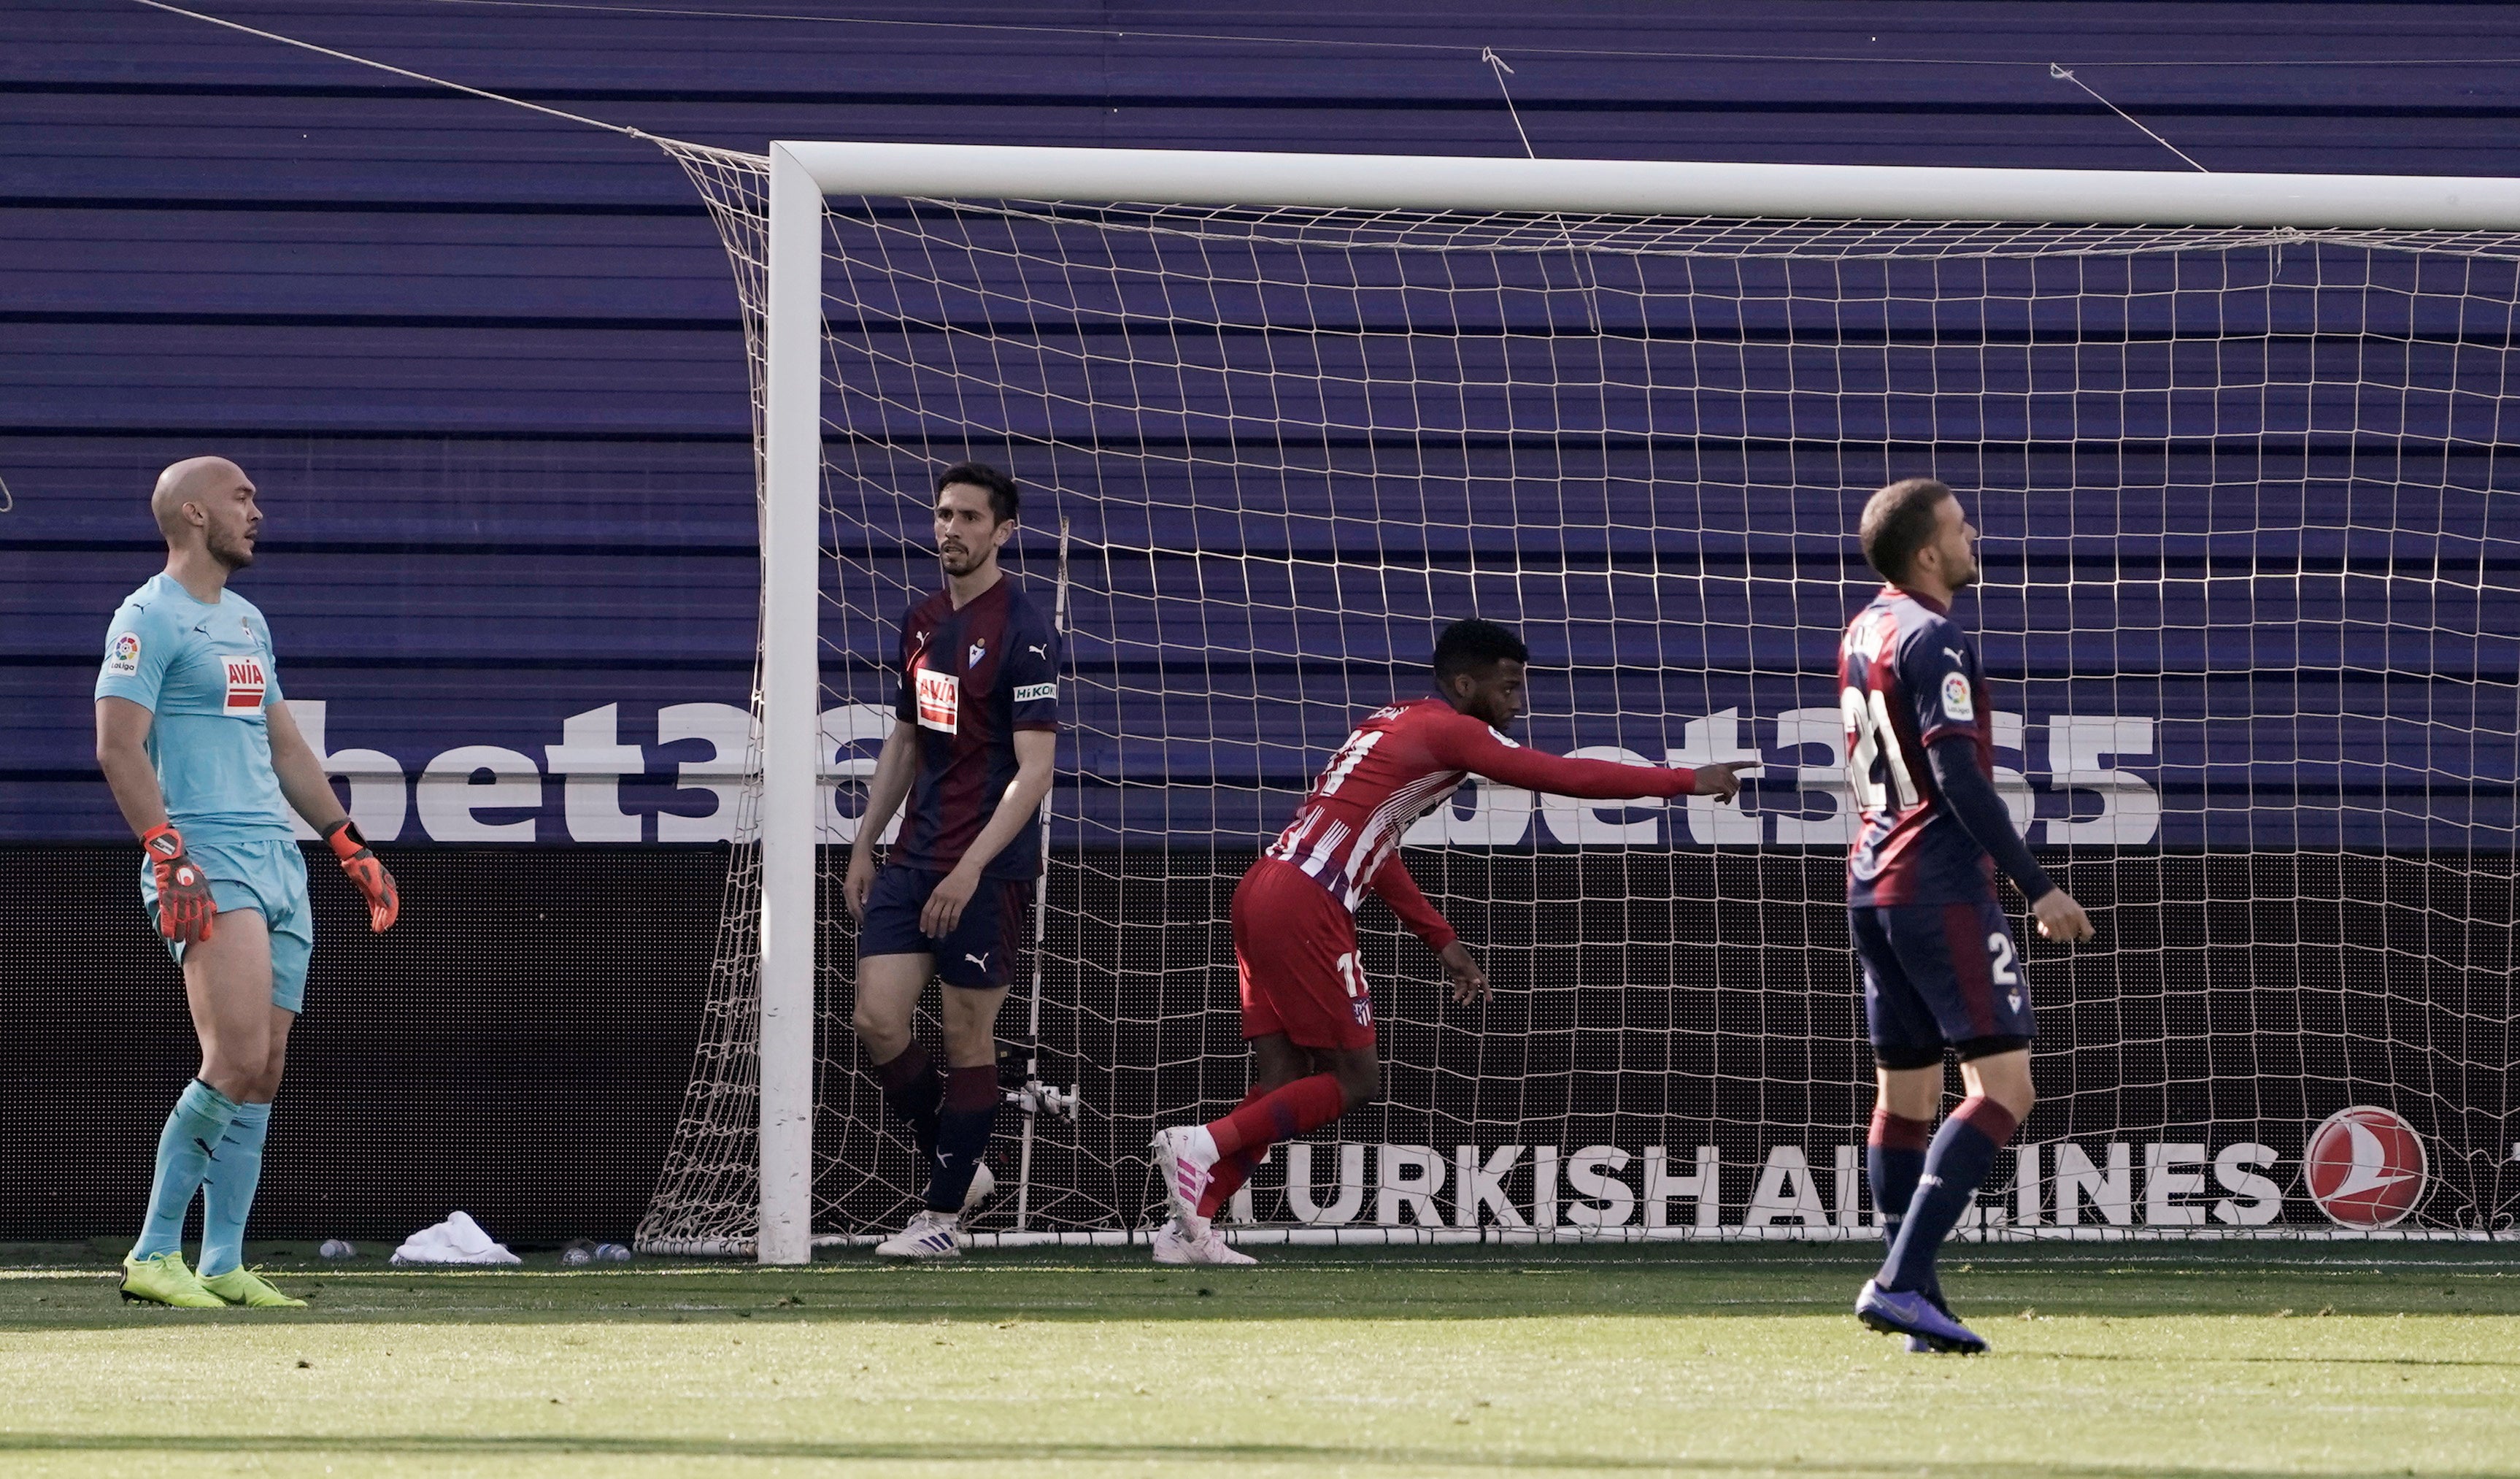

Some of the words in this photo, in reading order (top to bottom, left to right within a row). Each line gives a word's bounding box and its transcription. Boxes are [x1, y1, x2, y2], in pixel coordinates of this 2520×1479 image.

[111, 661, 135, 672] LaLiga
[282, 699, 912, 845] bet36
[1841, 685, 1920, 813] 21
[1987, 931, 2026, 986] 2
[1743, 1142, 2282, 1227] AIINES
